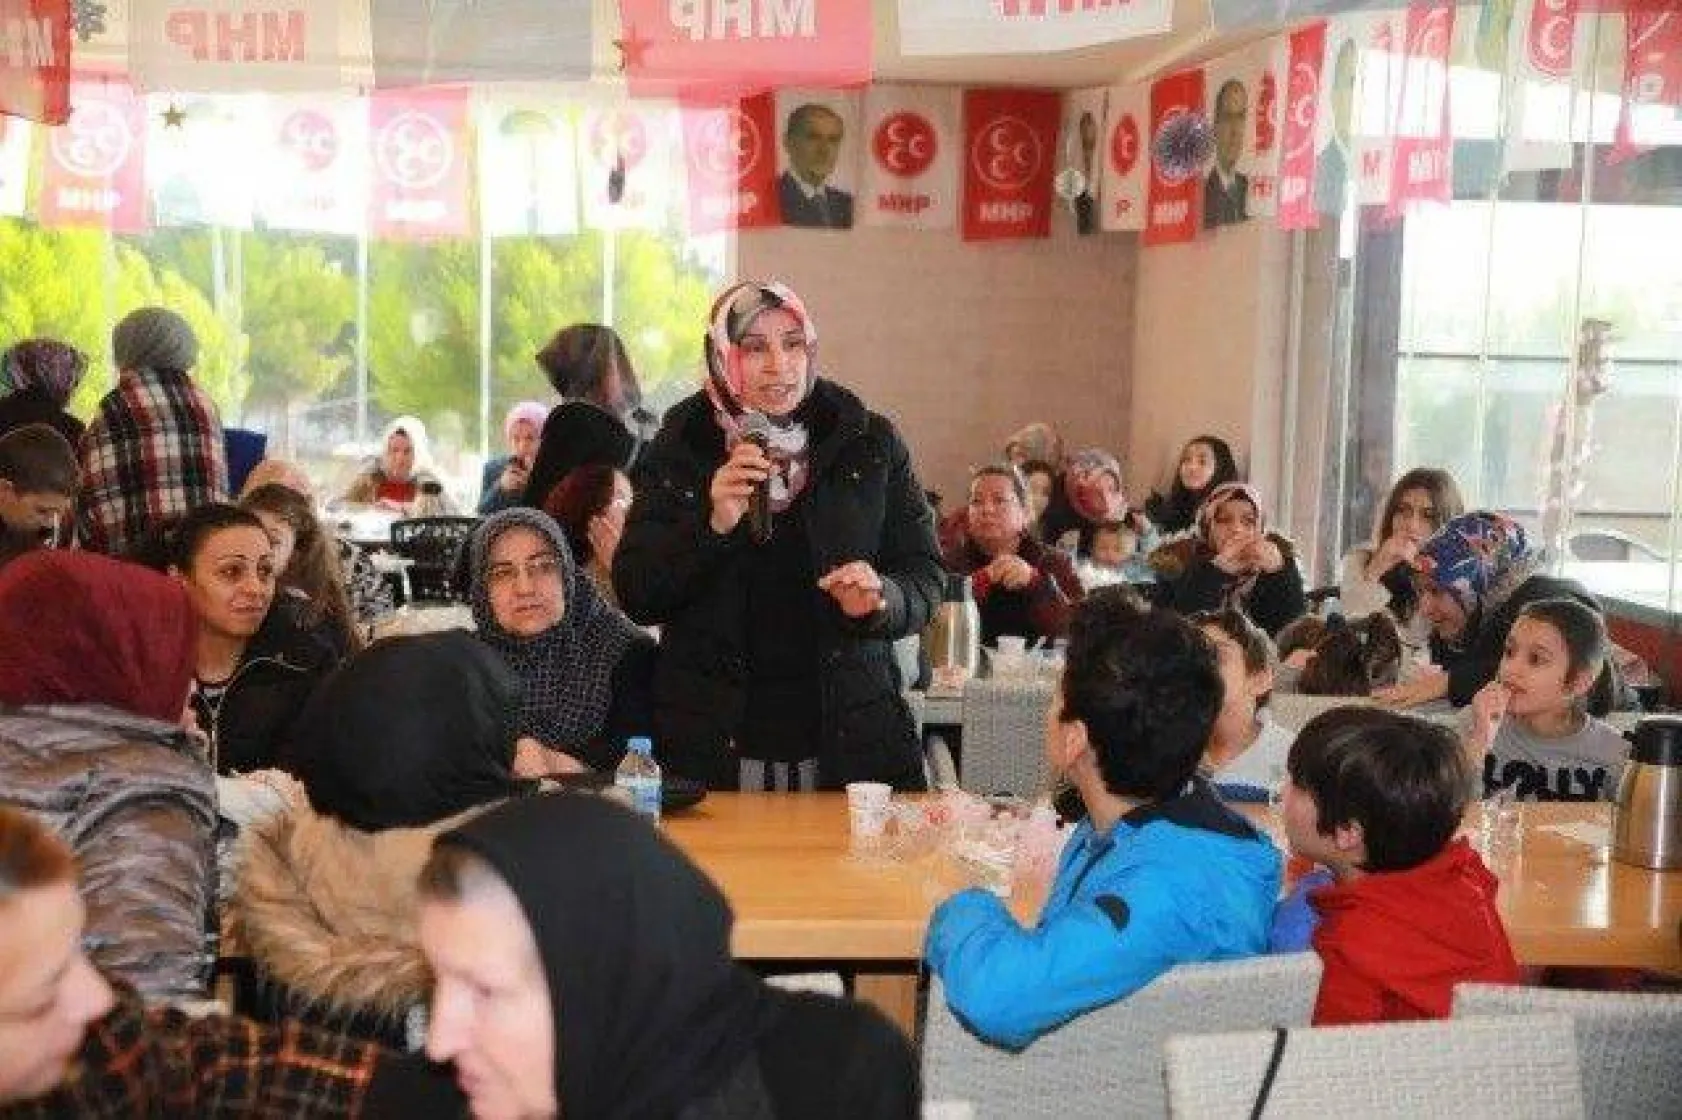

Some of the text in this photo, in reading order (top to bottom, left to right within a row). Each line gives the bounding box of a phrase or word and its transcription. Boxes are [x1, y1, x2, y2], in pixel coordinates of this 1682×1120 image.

[878, 193, 931, 214] MHP
[980, 202, 1033, 223] MHP
[1483, 754, 1607, 802] LOLLY
